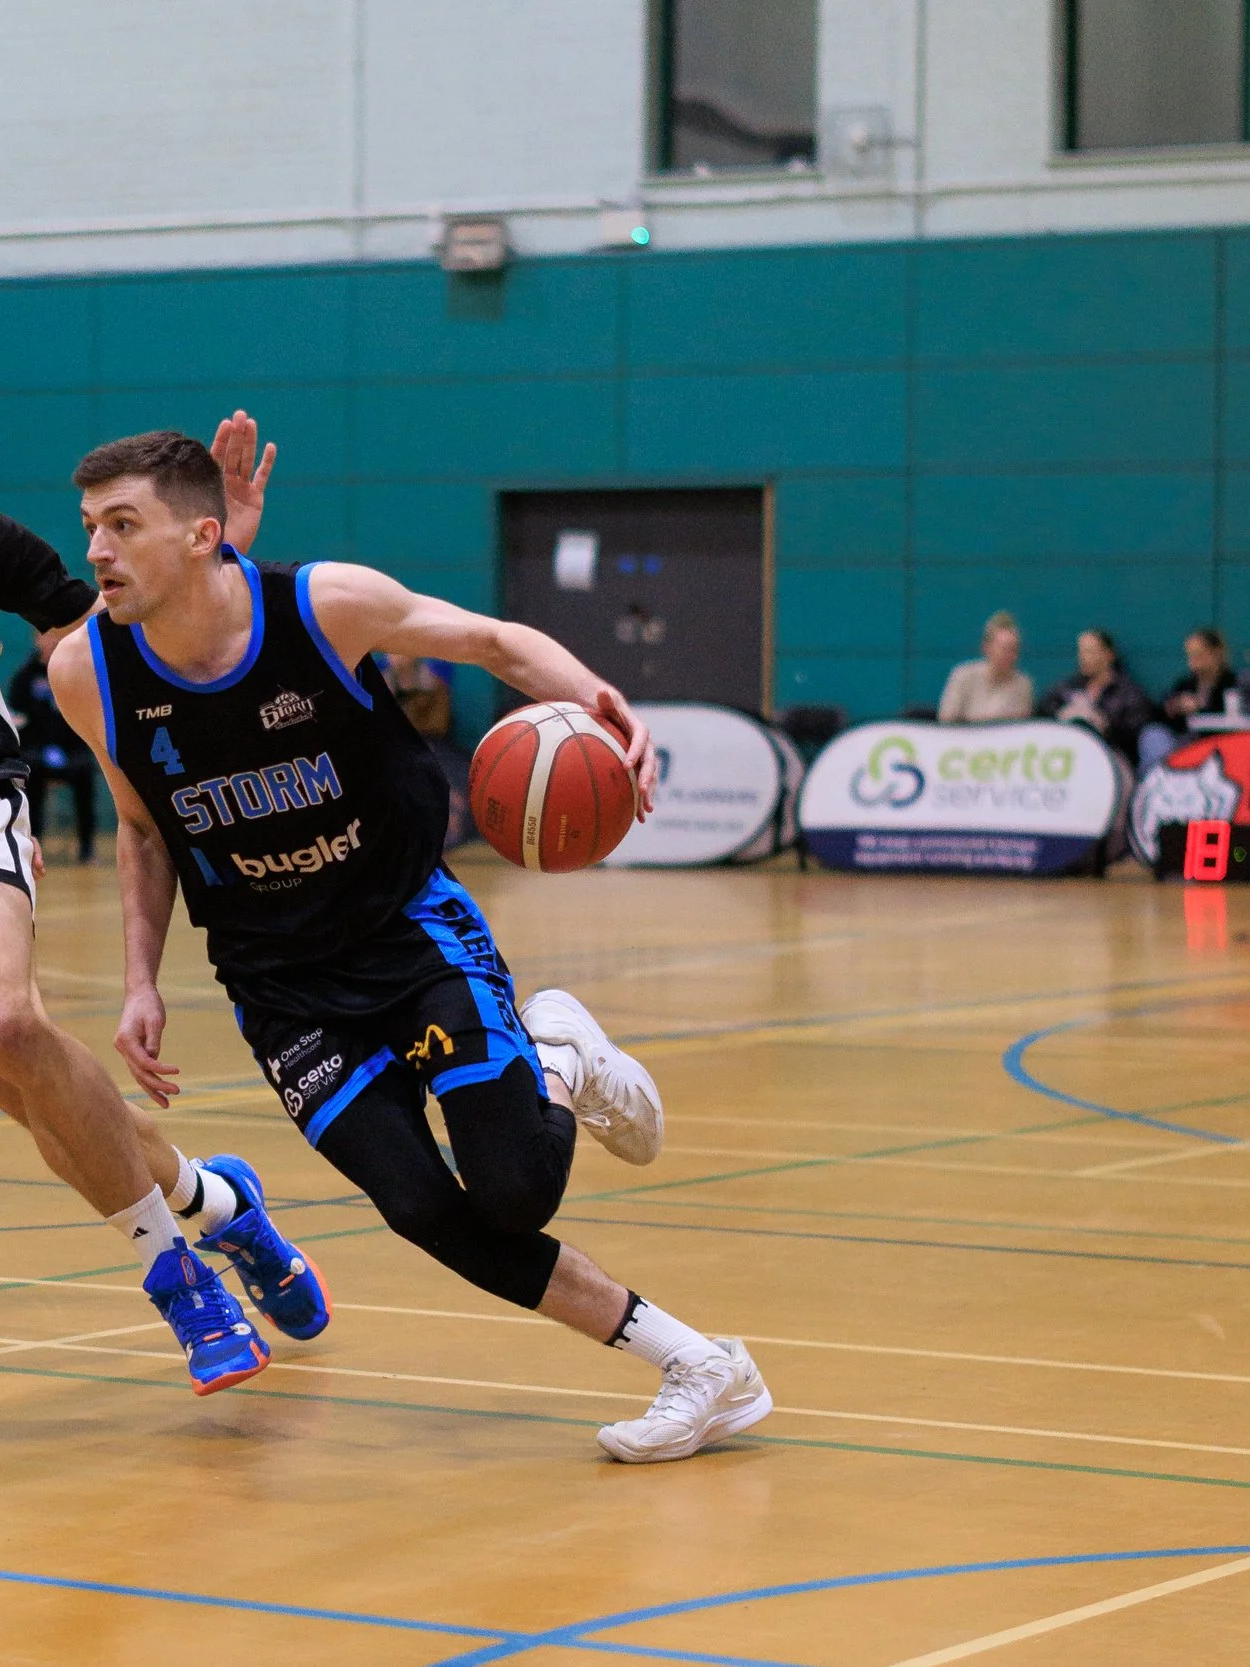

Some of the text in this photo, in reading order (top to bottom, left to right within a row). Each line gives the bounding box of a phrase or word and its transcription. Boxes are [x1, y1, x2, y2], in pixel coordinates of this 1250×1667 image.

[135, 704, 173, 720] TMB
[150, 727, 185, 775] 4
[937, 743, 1074, 782] certa
[171, 752, 343, 834] STORM
[231, 818, 362, 879] bugler
[1183, 819, 1231, 881] 18
[249, 877, 303, 893] GROUP
[280, 1028, 323, 1062] One Stop
[284, 1039, 323, 1070] Healthcare
[298, 1054, 343, 1090] certa
